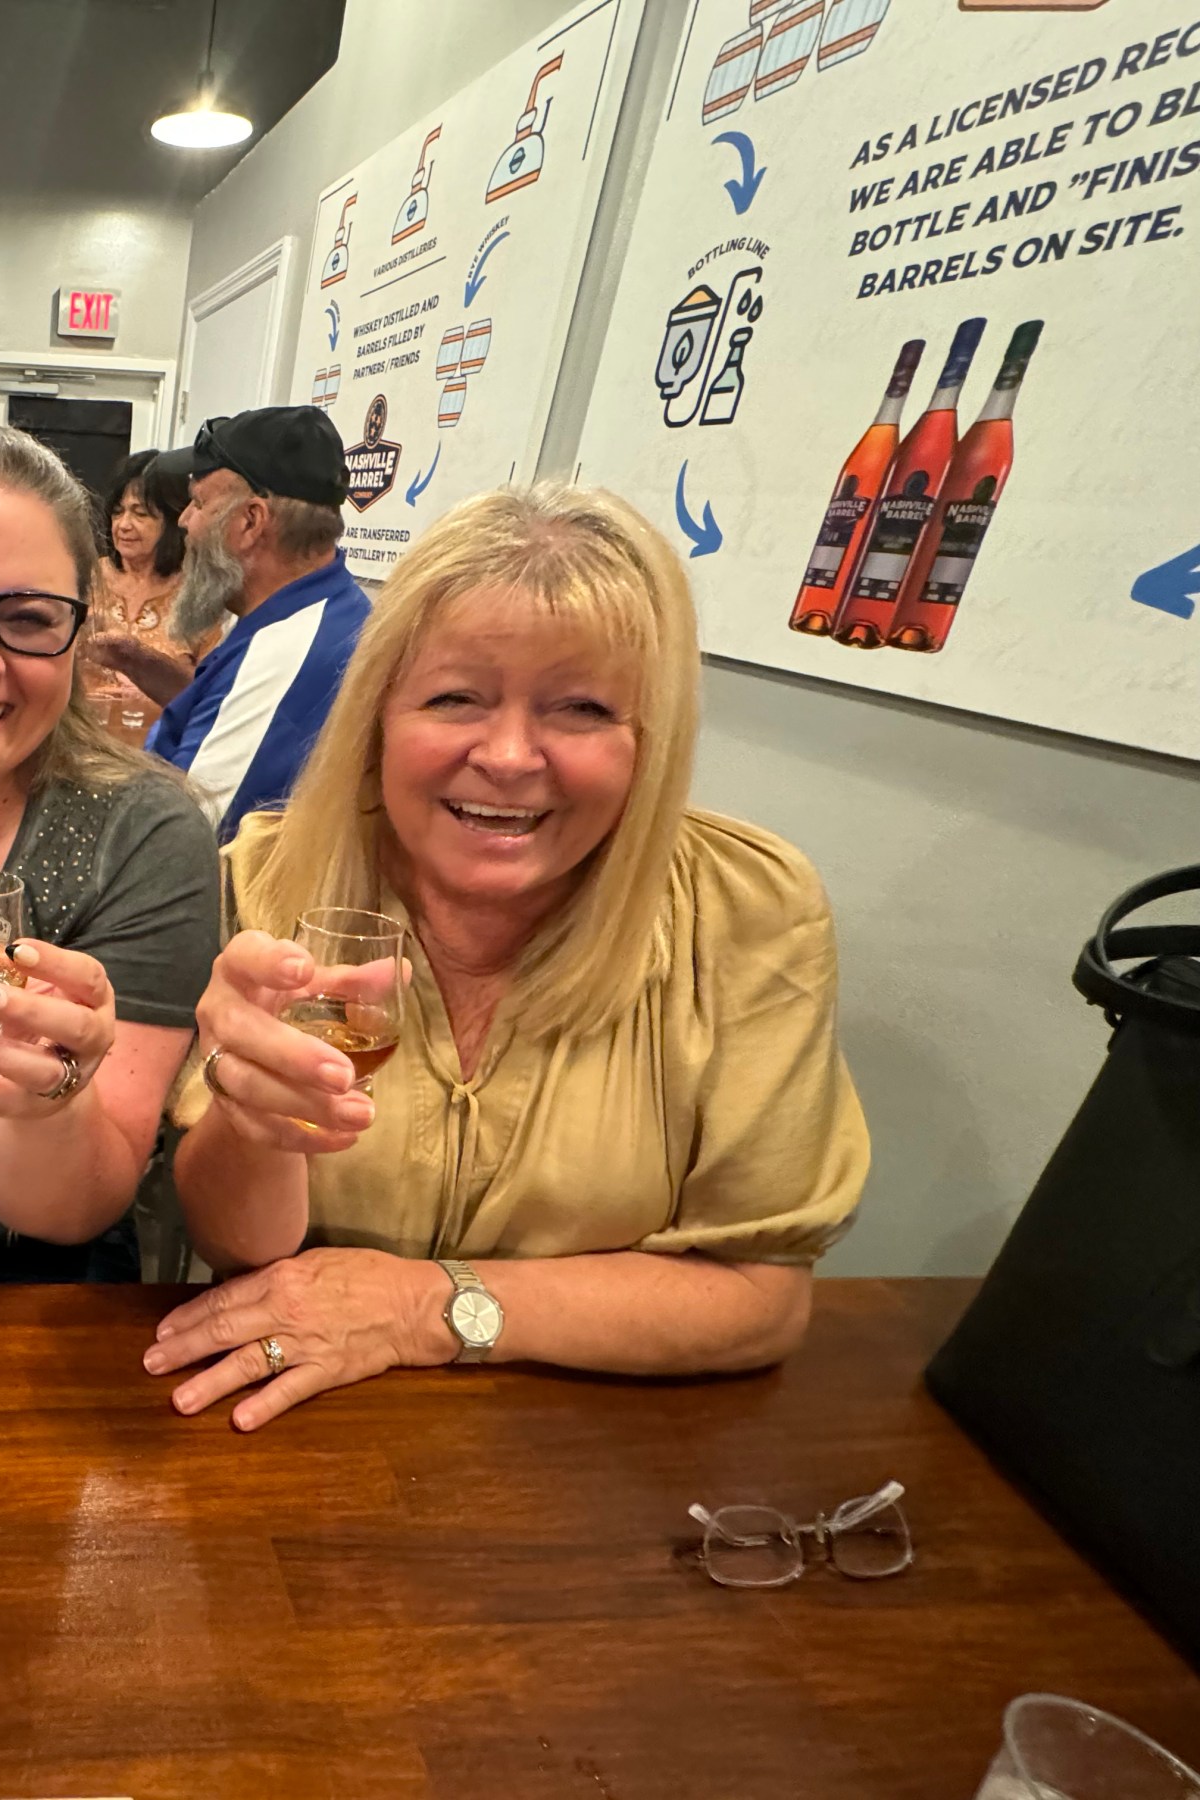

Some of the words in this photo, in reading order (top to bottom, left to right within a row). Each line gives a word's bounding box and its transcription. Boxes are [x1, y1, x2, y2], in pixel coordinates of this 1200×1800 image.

[849, 132, 893, 170] AS
[895, 124, 917, 154] A
[925, 57, 1107, 144] LICENSED
[849, 177, 895, 213] WE
[896, 155, 968, 200] ARE
[969, 121, 1074, 179] ABLE
[1082, 102, 1142, 146] TO
[848, 202, 971, 257] BOTTLE
[972, 181, 1057, 227] AND
[373, 258, 398, 278] VARIOUS
[398, 237, 438, 265] DISTILLERIES
[687, 237, 747, 280] BOTTLING
[746, 237, 771, 260] LINE
[856, 244, 1007, 299] BARRELS
[1012, 229, 1076, 268] ON
[1078, 205, 1184, 255] SITE.
[68, 292, 114, 330] EXIT
[353, 319, 383, 339] WHISKEY
[383, 303, 420, 327] DISTILLED
[421, 295, 440, 314] AND
[356, 337, 388, 358] BARRELS
[387, 329, 412, 349] FILLED
[412, 323, 425, 341] BY
[353, 360, 385, 380] PARTNERS
[390, 350, 420, 372] FRIENDS
[349, 471, 384, 488] BARREL
[886, 509, 924, 520] BARREL
[346, 527, 358, 538] ARE
[360, 528, 410, 542] TRANSFERRED
[348, 547, 386, 562] DISTILLERY
